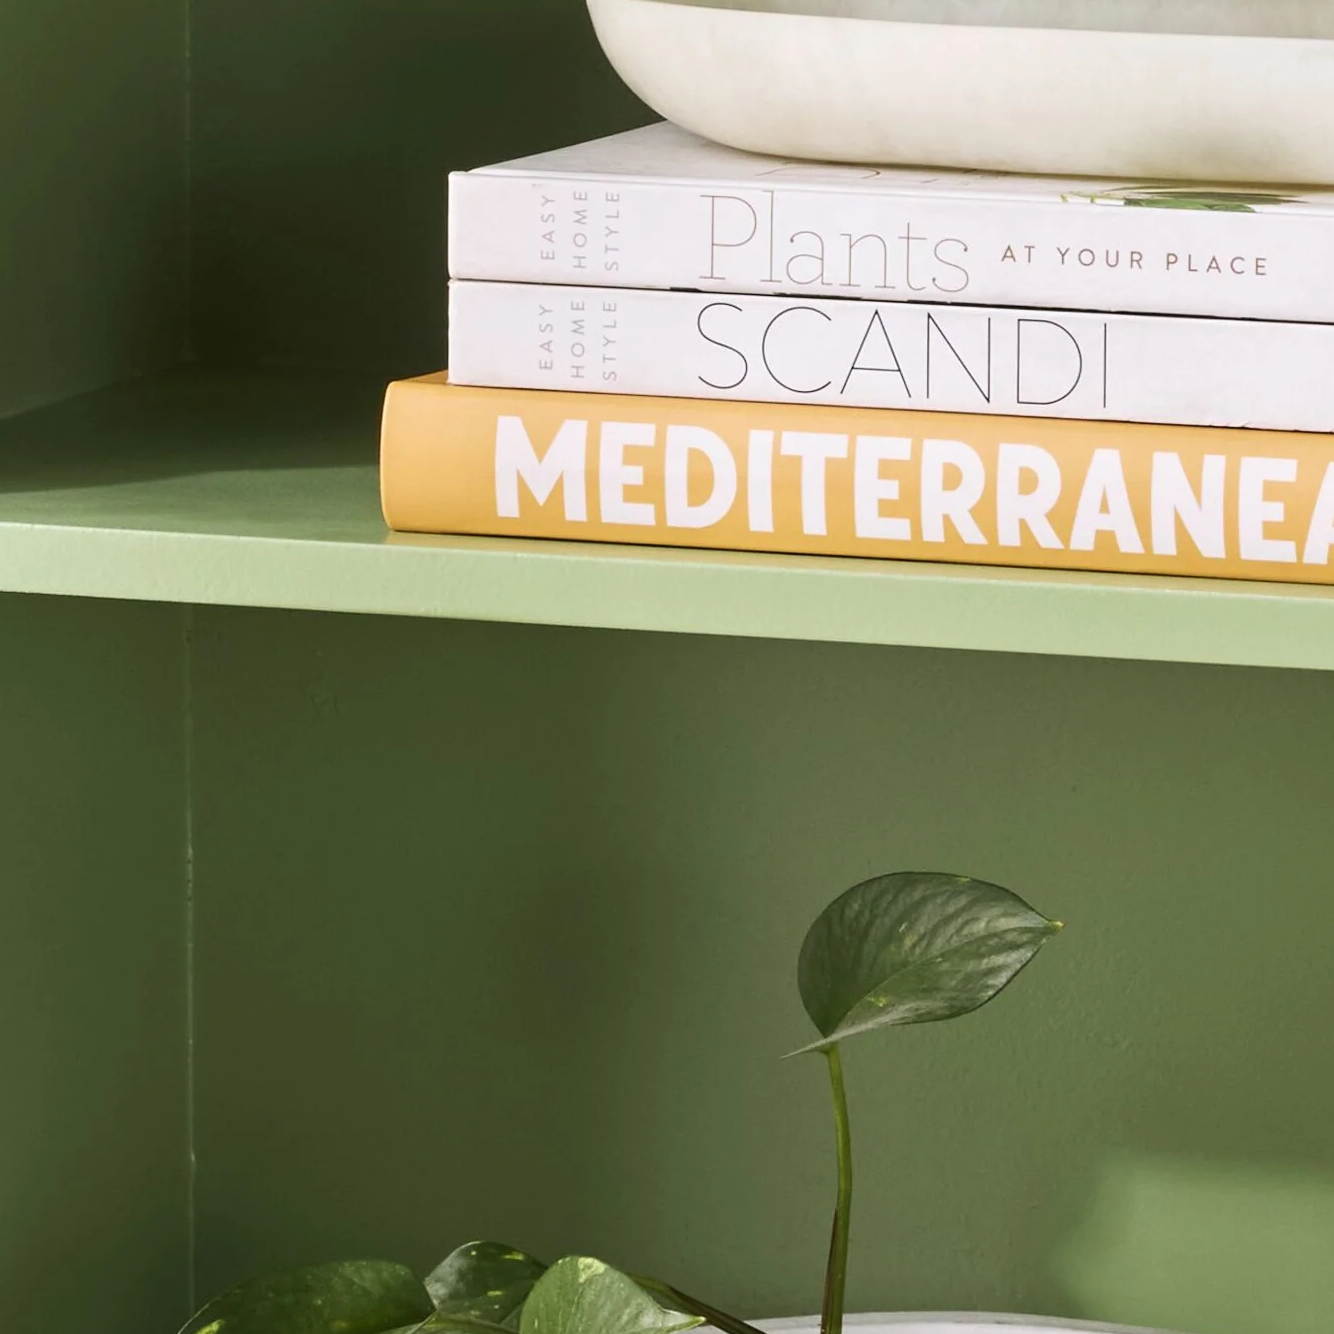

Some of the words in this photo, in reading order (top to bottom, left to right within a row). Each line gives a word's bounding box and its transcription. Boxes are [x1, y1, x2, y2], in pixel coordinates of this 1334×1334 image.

[540, 194, 556, 261] EASY
[572, 190, 588, 270] HOME
[604, 191, 620, 272] STYLE
[698, 189, 969, 293] Plants
[1000, 244, 1036, 264] AT
[1056, 246, 1144, 270] YOUR
[1165, 252, 1267, 276] PLACE
[538, 304, 554, 371] EASY
[570, 300, 586, 379] HOME
[602, 301, 618, 382] STYLE
[696, 302, 1108, 409] SCANDI
